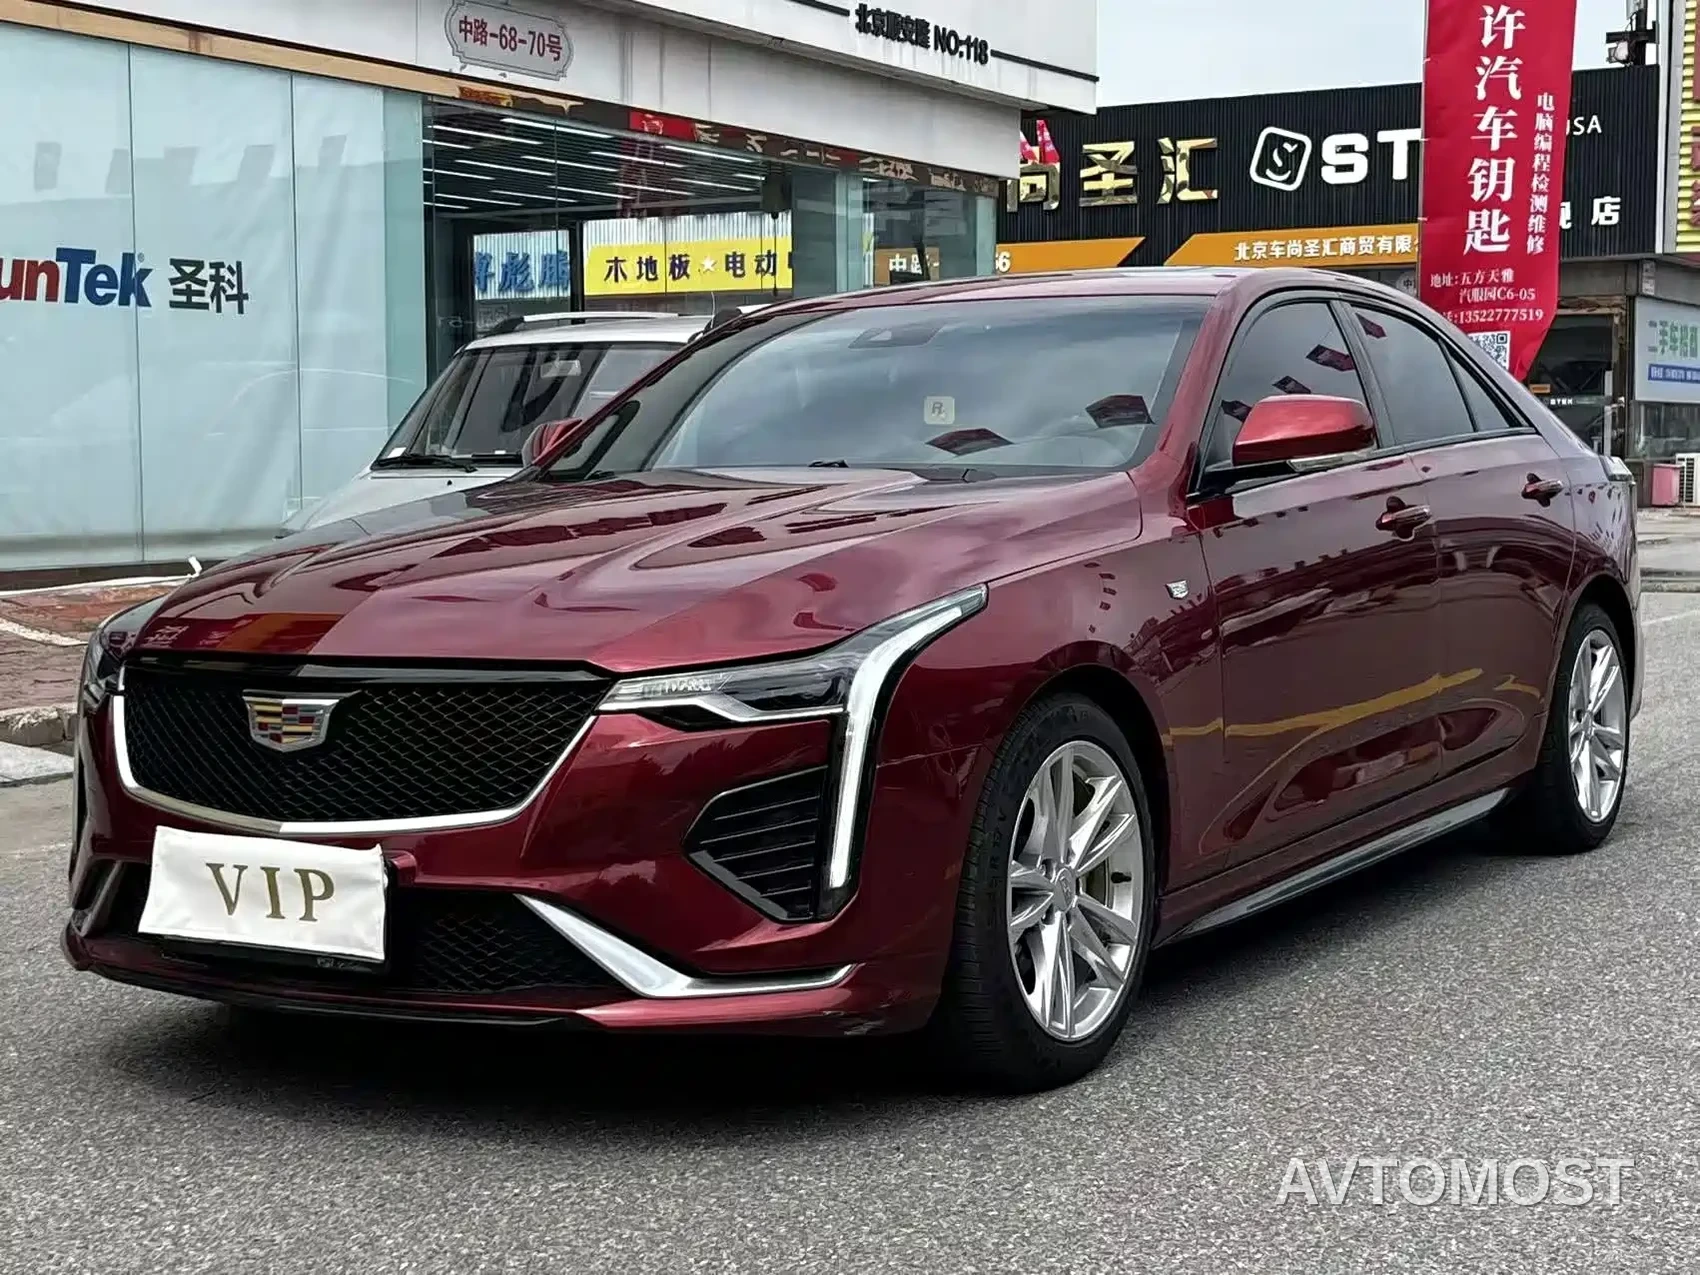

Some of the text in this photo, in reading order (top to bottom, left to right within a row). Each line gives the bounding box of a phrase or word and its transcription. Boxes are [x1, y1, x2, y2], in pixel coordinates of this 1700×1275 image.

[459, 15, 562, 61] 中路-68-70号
[1463, 5, 1526, 256] 许汽车钥匙
[1526, 92, 1556, 255] 电脑编程检测维修
[604, 253, 690, 283] 木地板
[1234, 233, 1419, 261] 北京车尚圣汇商贸有限
[168, 258, 249, 315] 圣科
[206, 862, 335, 922] VIP
